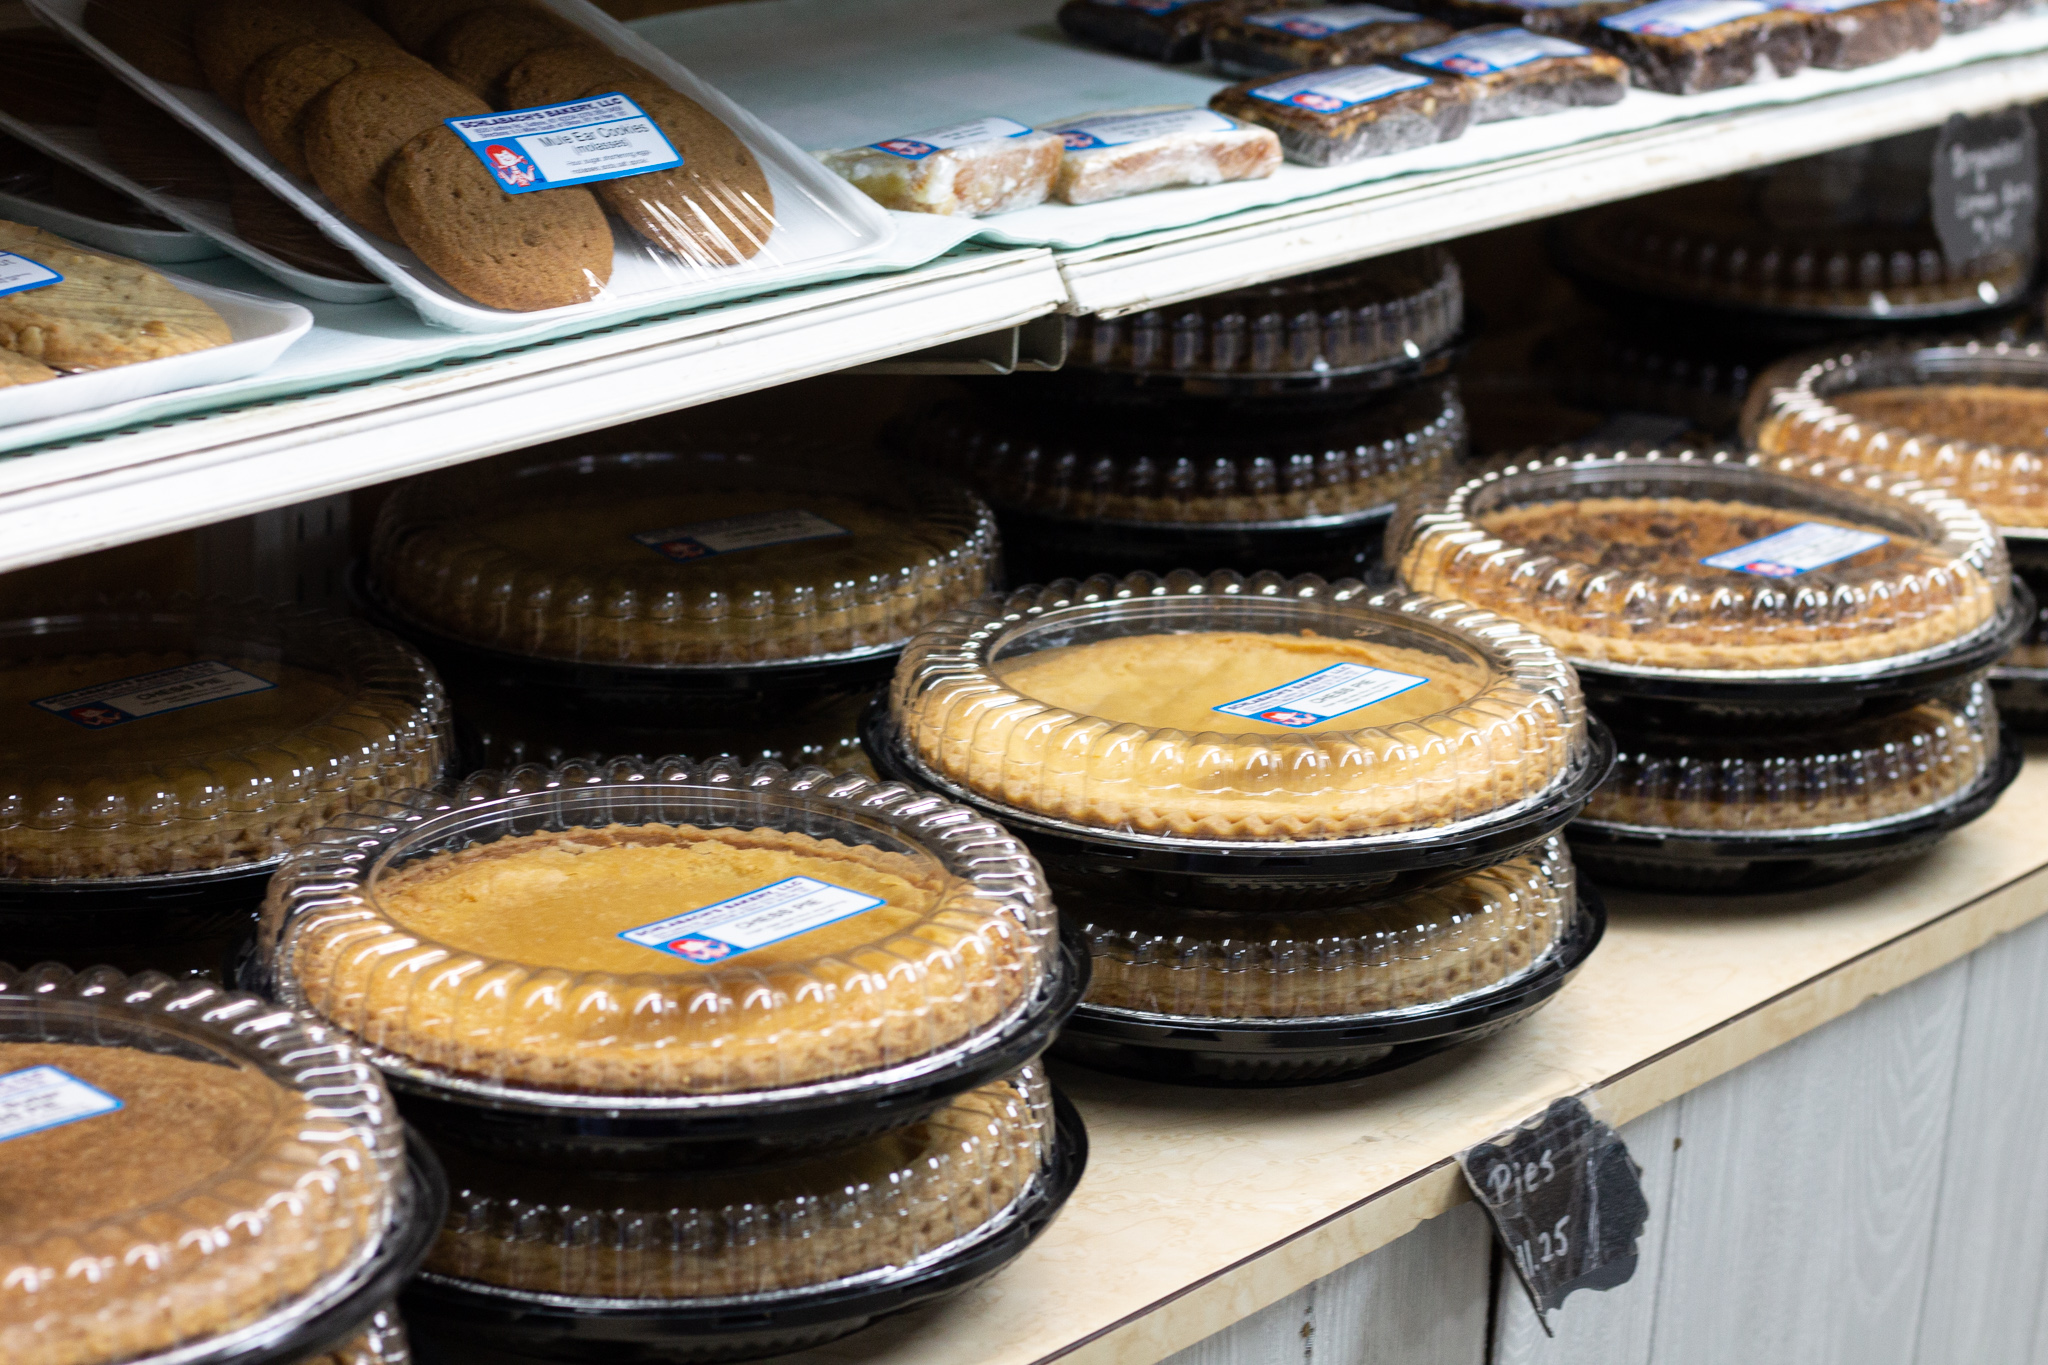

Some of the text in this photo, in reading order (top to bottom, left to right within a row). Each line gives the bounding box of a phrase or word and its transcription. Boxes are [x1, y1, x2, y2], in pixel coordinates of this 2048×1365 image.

[459, 112, 545, 129] SCHLABACH'S
[597, 97, 623, 107] LLC
[538, 123, 650, 147] Mule Ear Cookies
[1486, 1149, 1556, 1203] Pies
